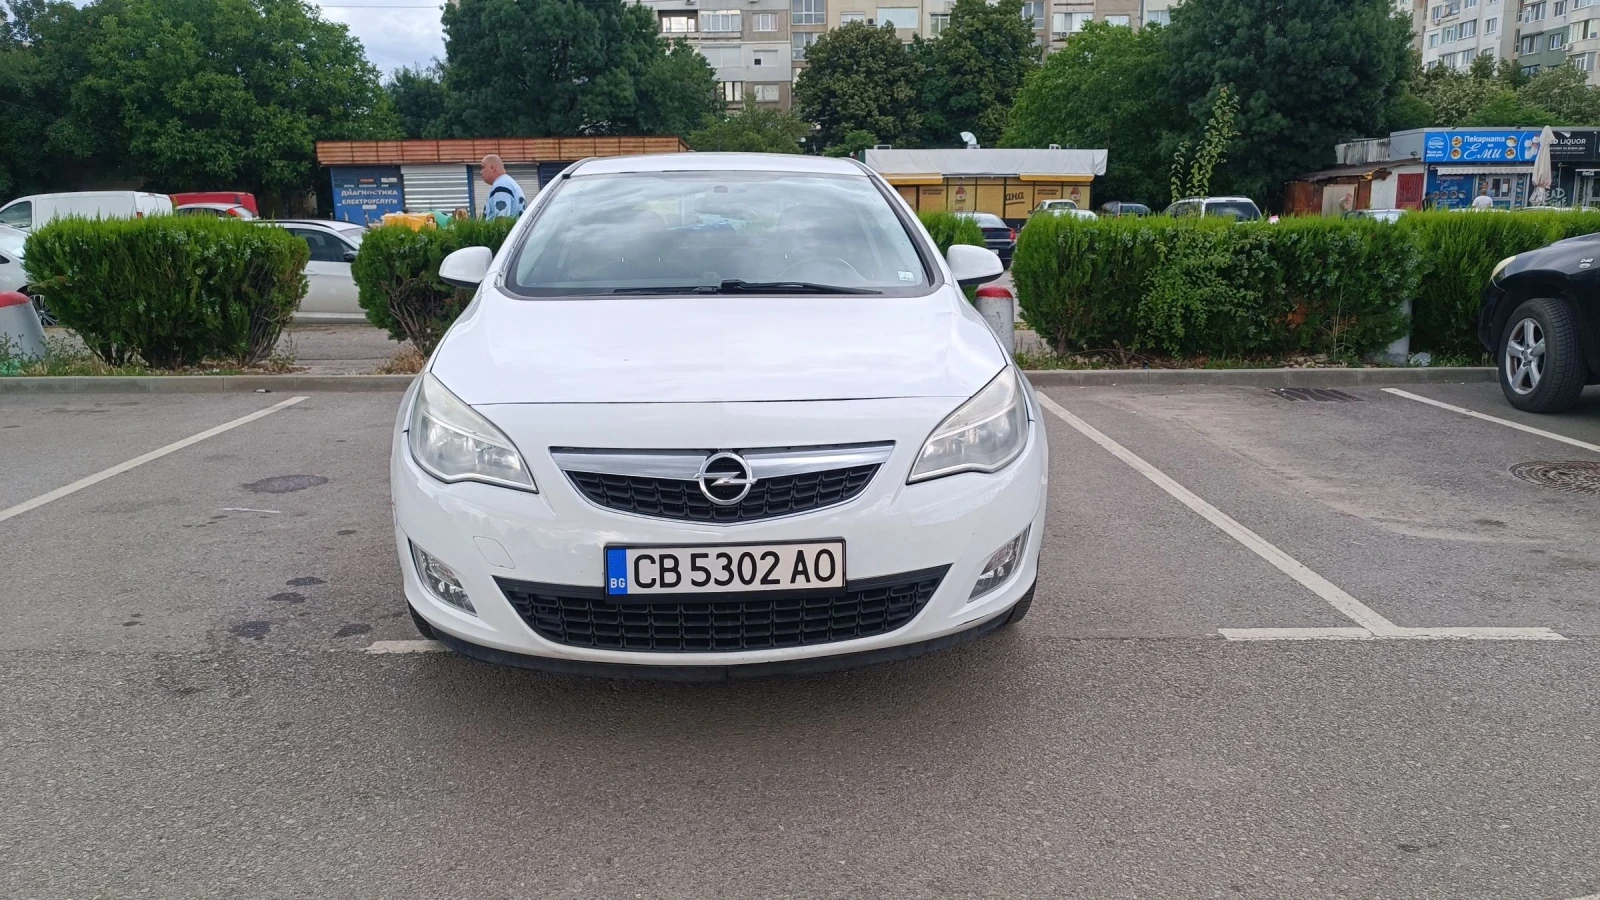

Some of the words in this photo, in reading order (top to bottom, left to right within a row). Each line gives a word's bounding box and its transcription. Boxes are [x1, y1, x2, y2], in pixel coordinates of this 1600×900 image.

[1463, 143, 1502, 160] Еми
[633, 553, 682, 589] CB
[690, 551, 781, 587] 5302
[789, 548, 836, 584] AO
[610, 578, 626, 589] BG
